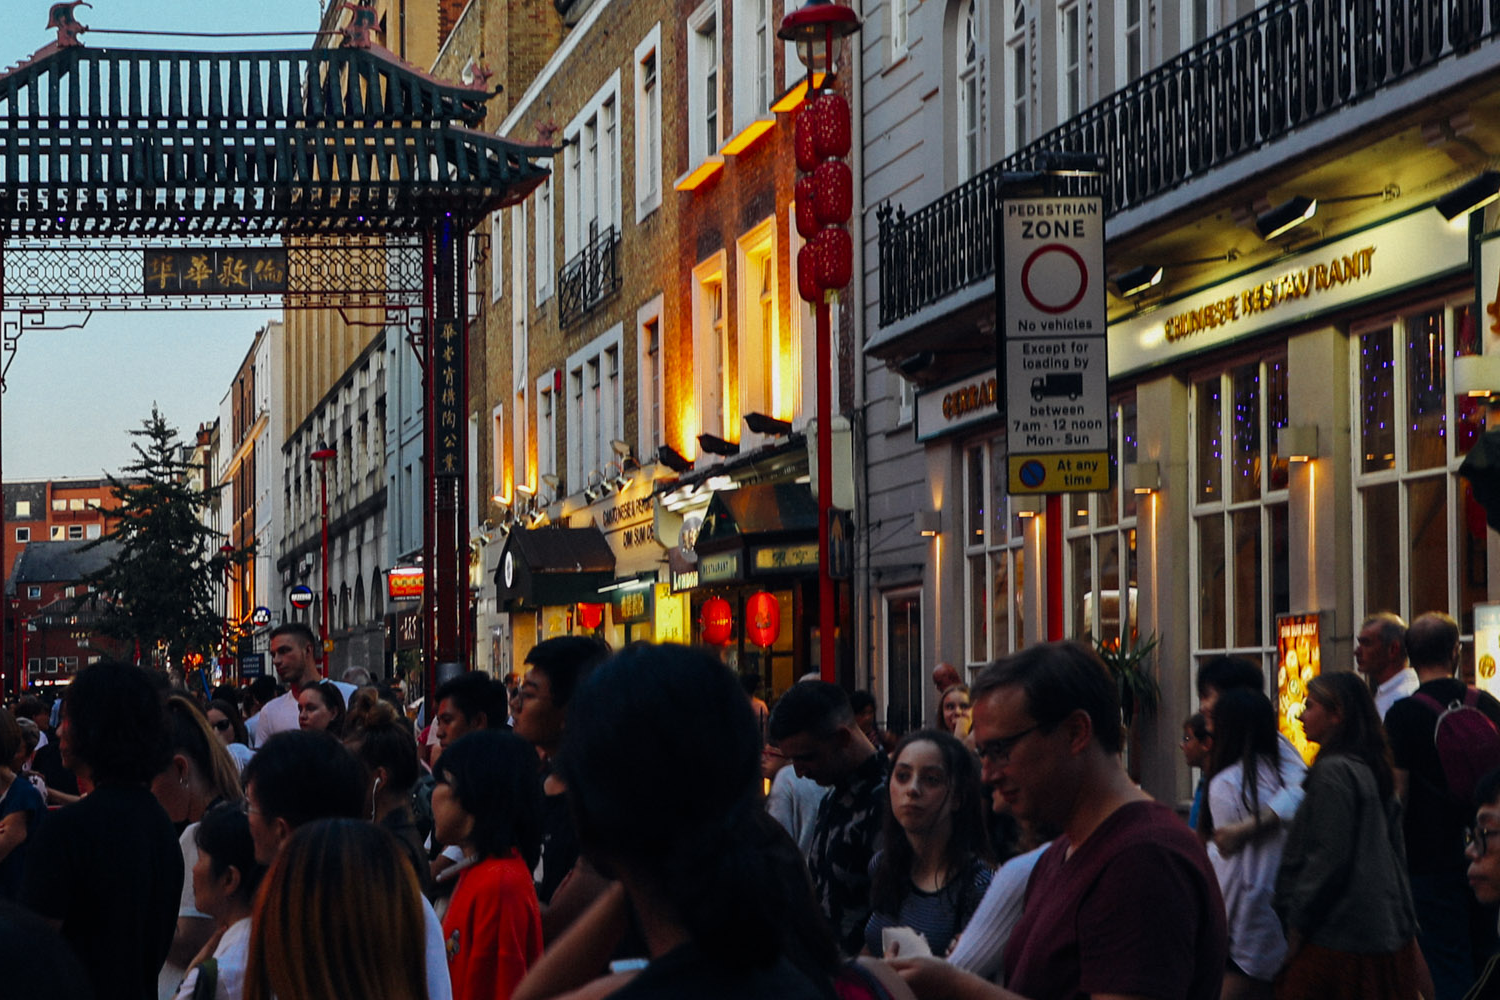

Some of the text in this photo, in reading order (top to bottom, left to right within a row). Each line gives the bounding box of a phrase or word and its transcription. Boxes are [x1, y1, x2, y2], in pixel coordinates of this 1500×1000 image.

[1008, 203, 1097, 217] PEDESTRIAN
[1022, 219, 1085, 239] ZONE
[1165, 244, 1377, 343] CHINESE RESTAURANT
[1018, 317, 1092, 331] No vehicles
[1023, 341, 1089, 355] Except for
[1022, 357, 1089, 370] loading by
[1030, 405, 1085, 417] between
[1014, 420, 1041, 432] 7am
[1053, 419, 1067, 431] 12
[1071, 419, 1102, 430] noon
[1026, 435, 1053, 446] Mon
[1065, 434, 1089, 445] Sun
[1057, 459, 1098, 472] At any
[1063, 475, 1092, 486] time
[701, 561, 728, 575] RESTAURANT
